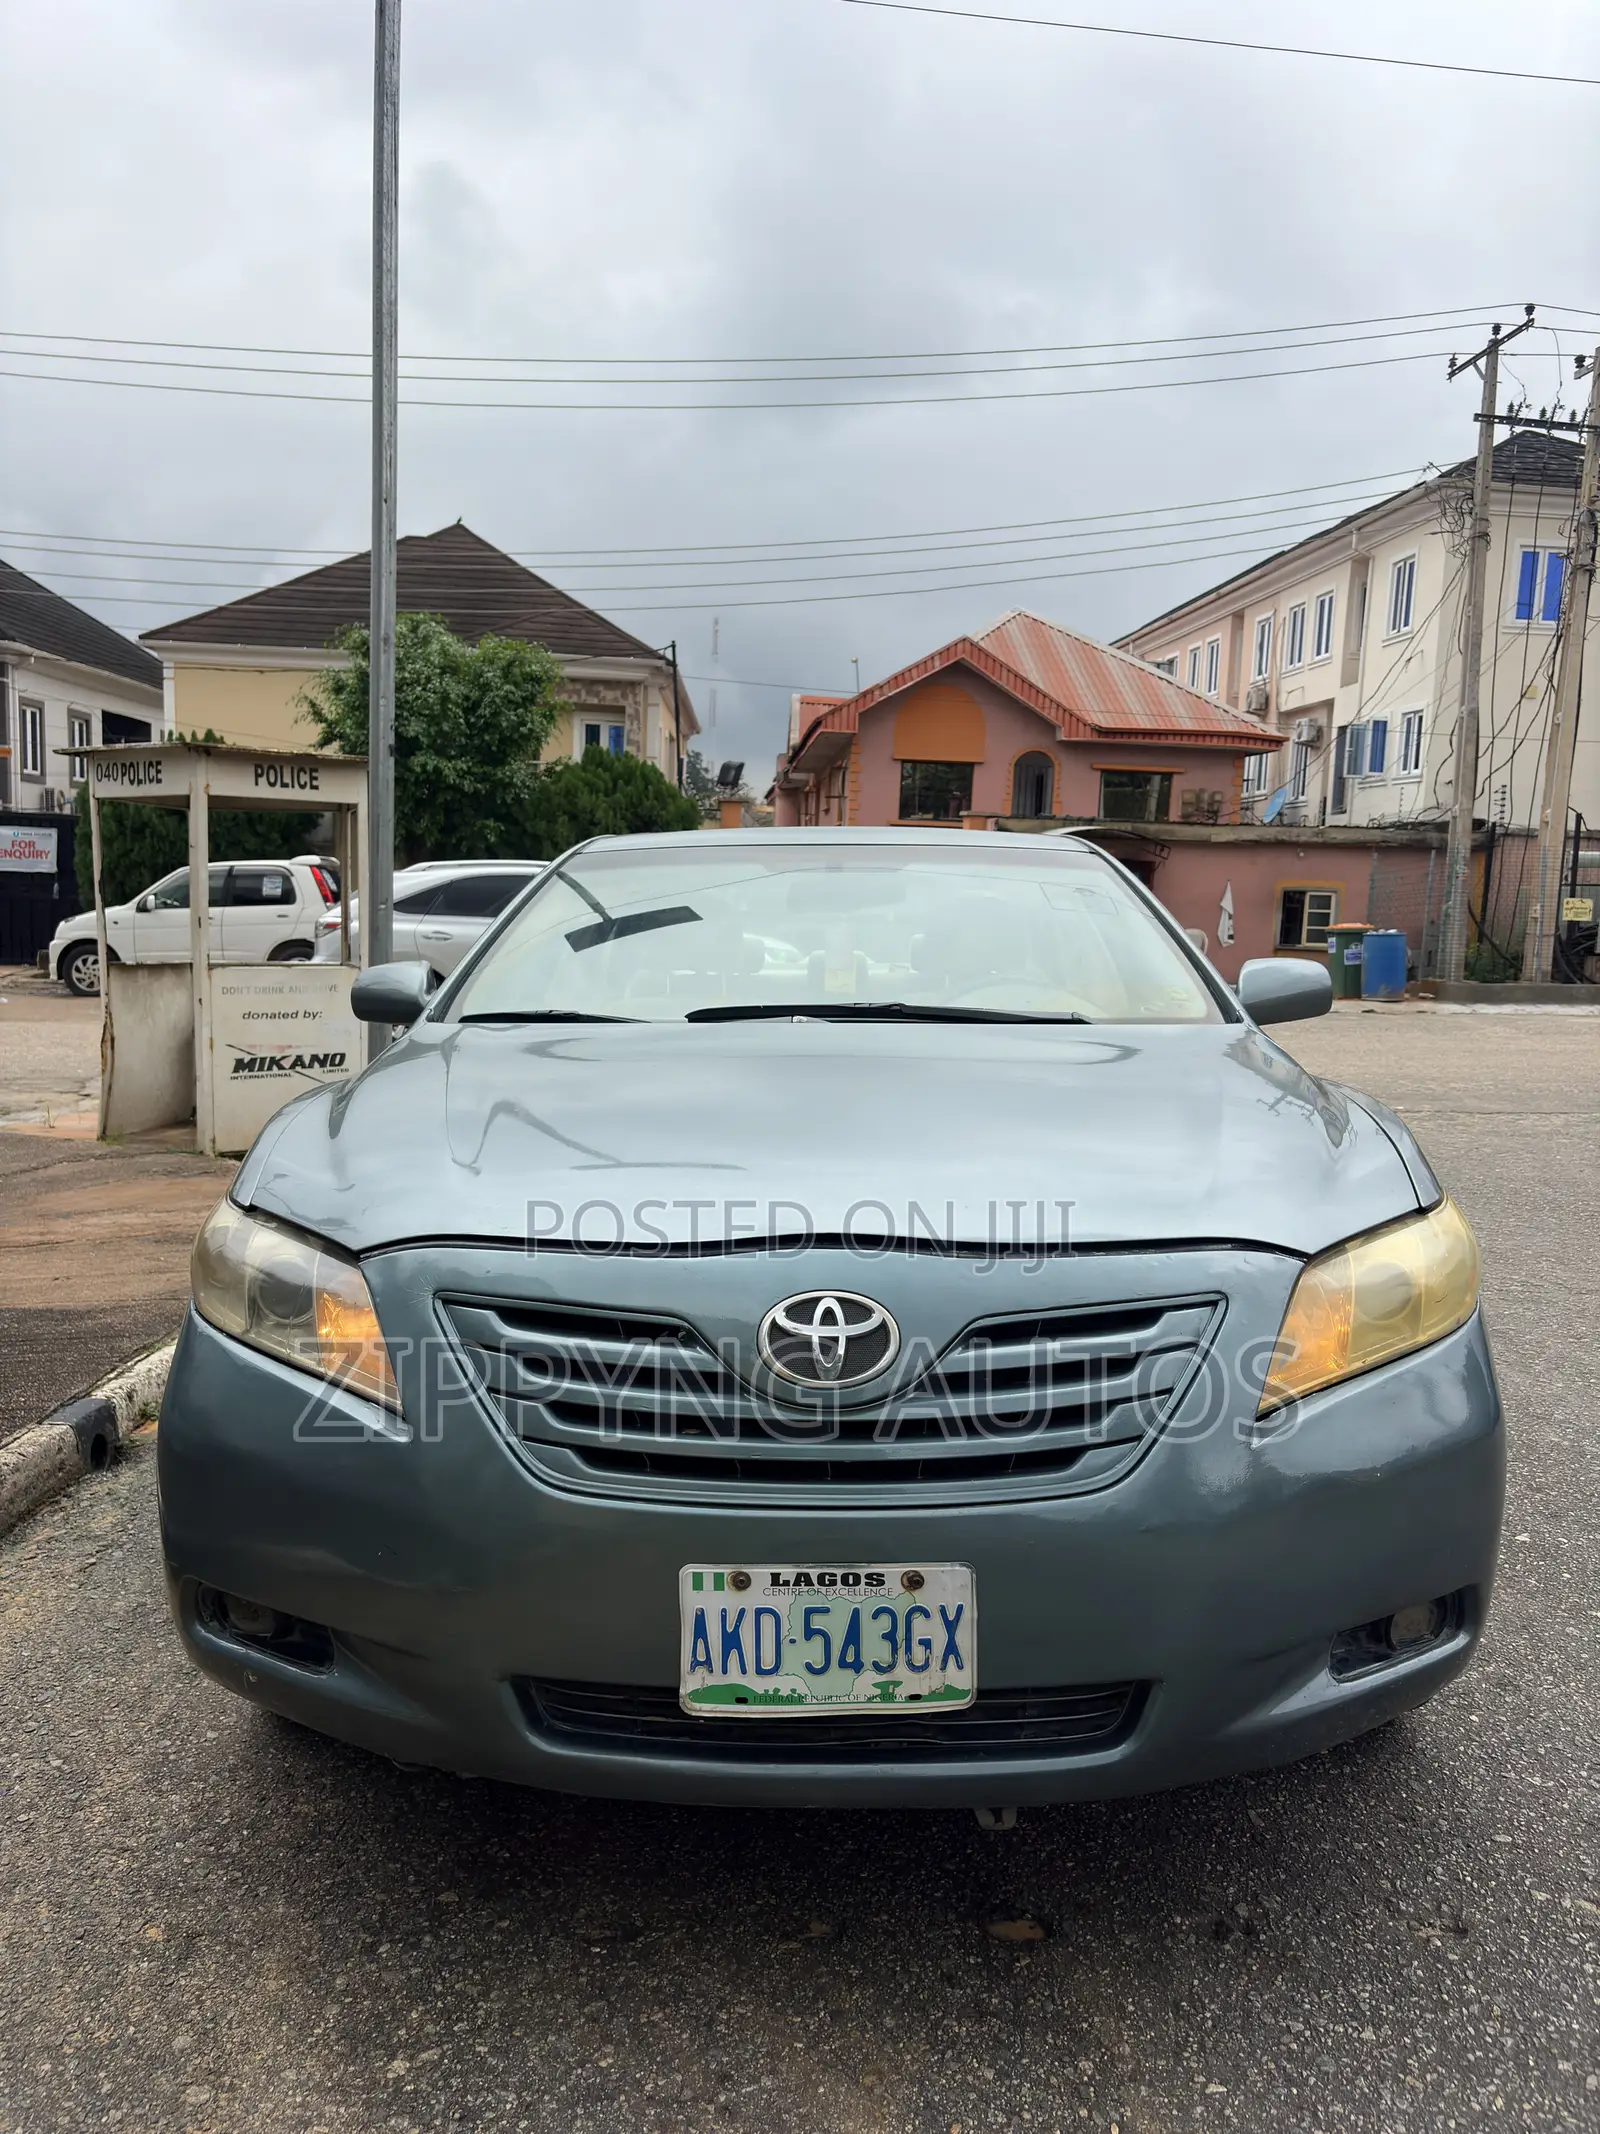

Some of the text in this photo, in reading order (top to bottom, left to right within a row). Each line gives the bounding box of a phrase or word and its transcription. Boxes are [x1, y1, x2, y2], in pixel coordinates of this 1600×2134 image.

[96, 760, 163, 787] 040 POLICE
[254, 763, 320, 791] POLICE
[11, 839, 37, 850] FOR
[242, 1009, 323, 1020] donated by:
[231, 1052, 347, 1074] MIKANO
[230, 1072, 293, 1081] INTERNATIONAL
[769, 1572, 886, 1588] LAGOS
[762, 1587, 893, 1597] CENTRE OF EXCELLENCE
[689, 1603, 965, 1676] AKD-543GX
[753, 1694, 797, 1704] FEDERAL
[848, 1693, 861, 1702] OF
[864, 1693, 905, 1702] NIGERIA
